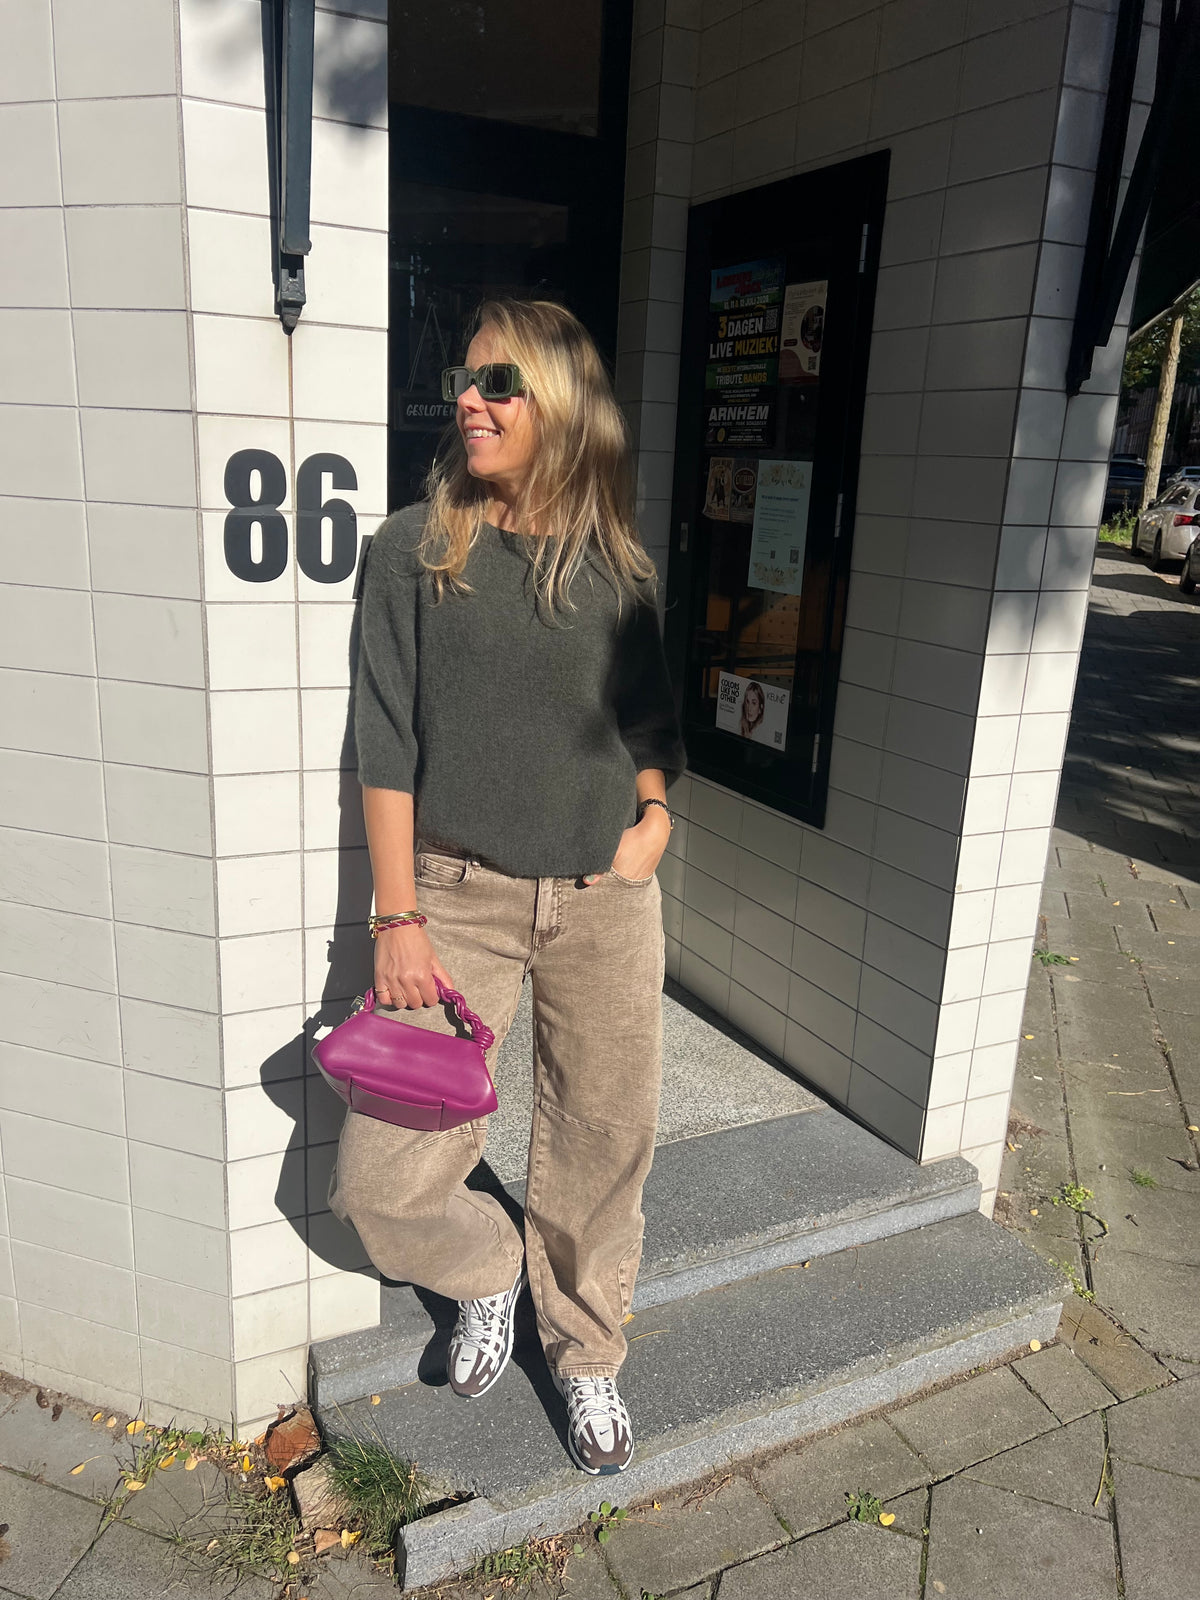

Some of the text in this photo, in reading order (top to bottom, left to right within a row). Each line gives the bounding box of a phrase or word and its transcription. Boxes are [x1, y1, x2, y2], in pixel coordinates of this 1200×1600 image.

[718, 315, 763, 338] 3 DAGEN
[709, 341, 734, 359] LIVE
[734, 336, 778, 357] MUZIEK!
[715, 372, 767, 385] TRIBUTE BANDS
[708, 405, 769, 421] ARNHEM
[224, 449, 358, 584] 86
[721, 679, 739, 690] COLORS
[721, 686, 730, 695] LIKE
[720, 693, 736, 704] OTHER
